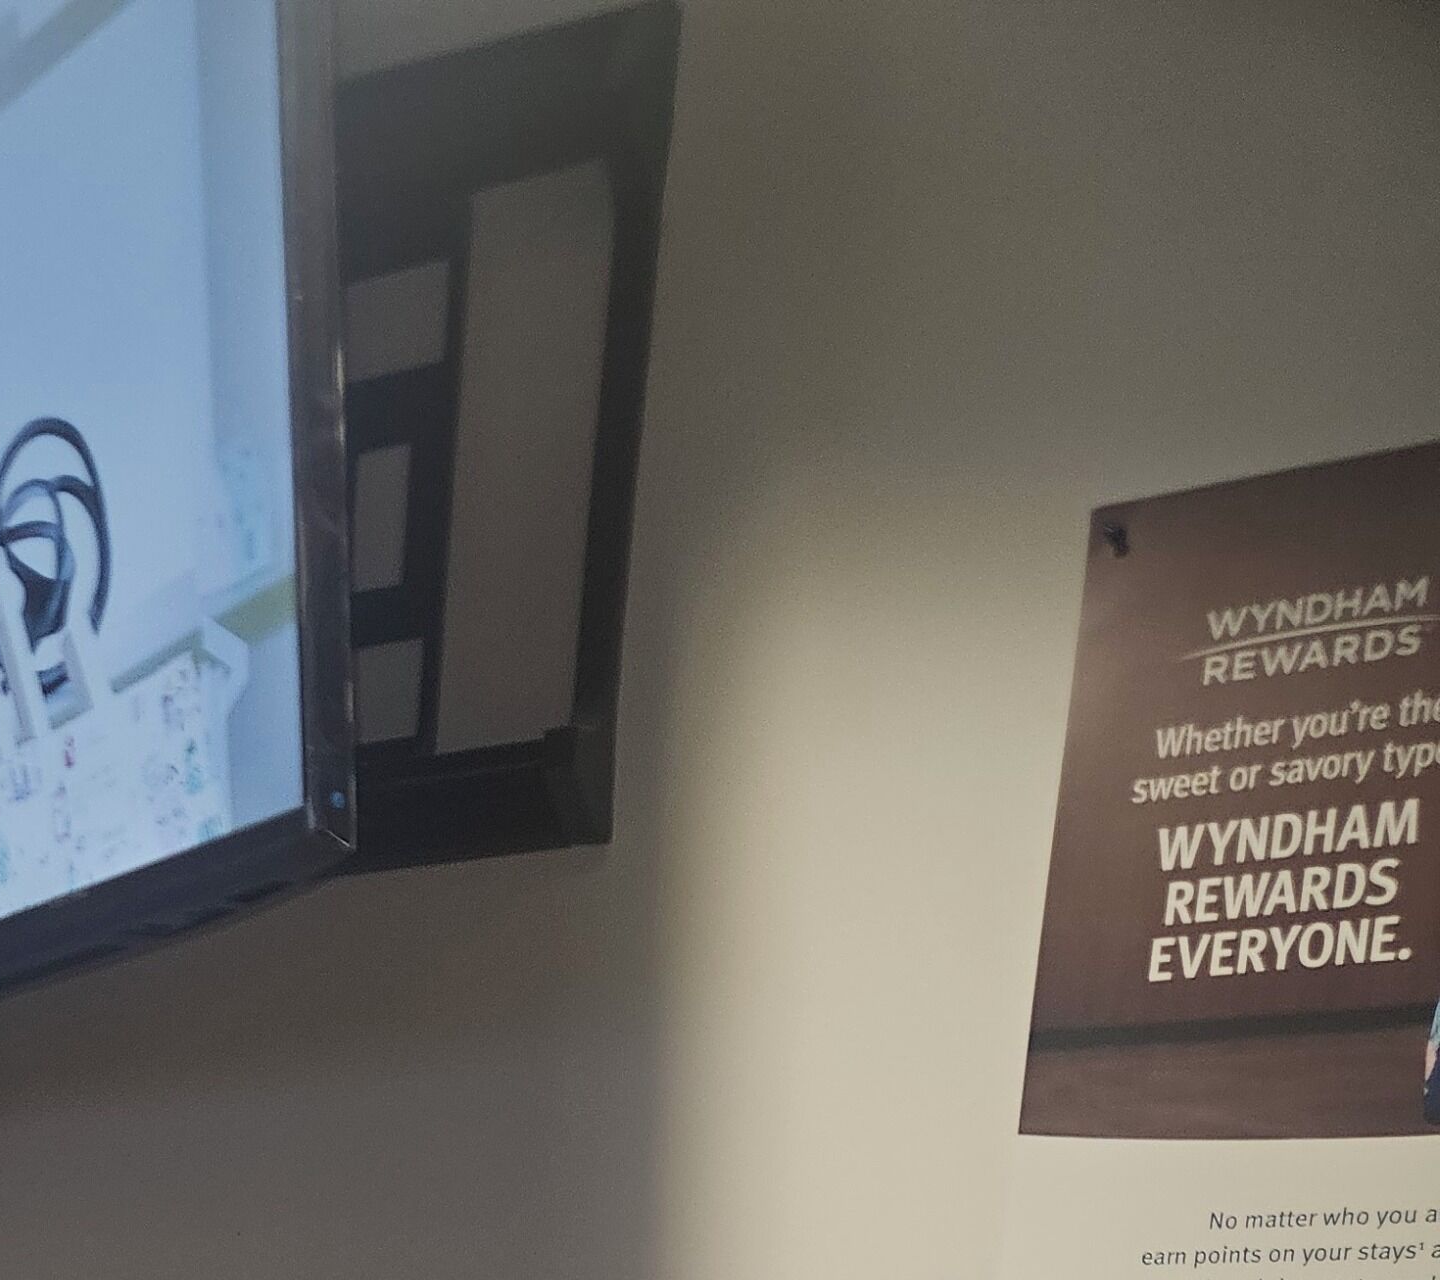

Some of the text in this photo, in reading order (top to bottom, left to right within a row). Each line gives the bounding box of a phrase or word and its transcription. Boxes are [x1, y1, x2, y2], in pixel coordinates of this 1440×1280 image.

[1207, 576, 1429, 640] WYNDHAM
[1203, 624, 1422, 686] REWARDS
[1156, 715, 1285, 759] Whether
[1292, 699, 1391, 749] you're
[1132, 740, 1440, 804] sweet or savory typ
[1158, 798, 1420, 872] WYNDHAM
[1164, 857, 1402, 926] REWARDS
[1148, 915, 1413, 983] EVERYONE.
[1209, 1212, 1238, 1230] No
[1245, 1210, 1318, 1229] matter
[1323, 1207, 1370, 1226] who
[1377, 1208, 1418, 1229] you
[1141, 1251, 1187, 1266] earn
[1194, 1245, 1262, 1269] points
[1268, 1249, 1295, 1263] on
[1302, 1247, 1353, 1267] your
